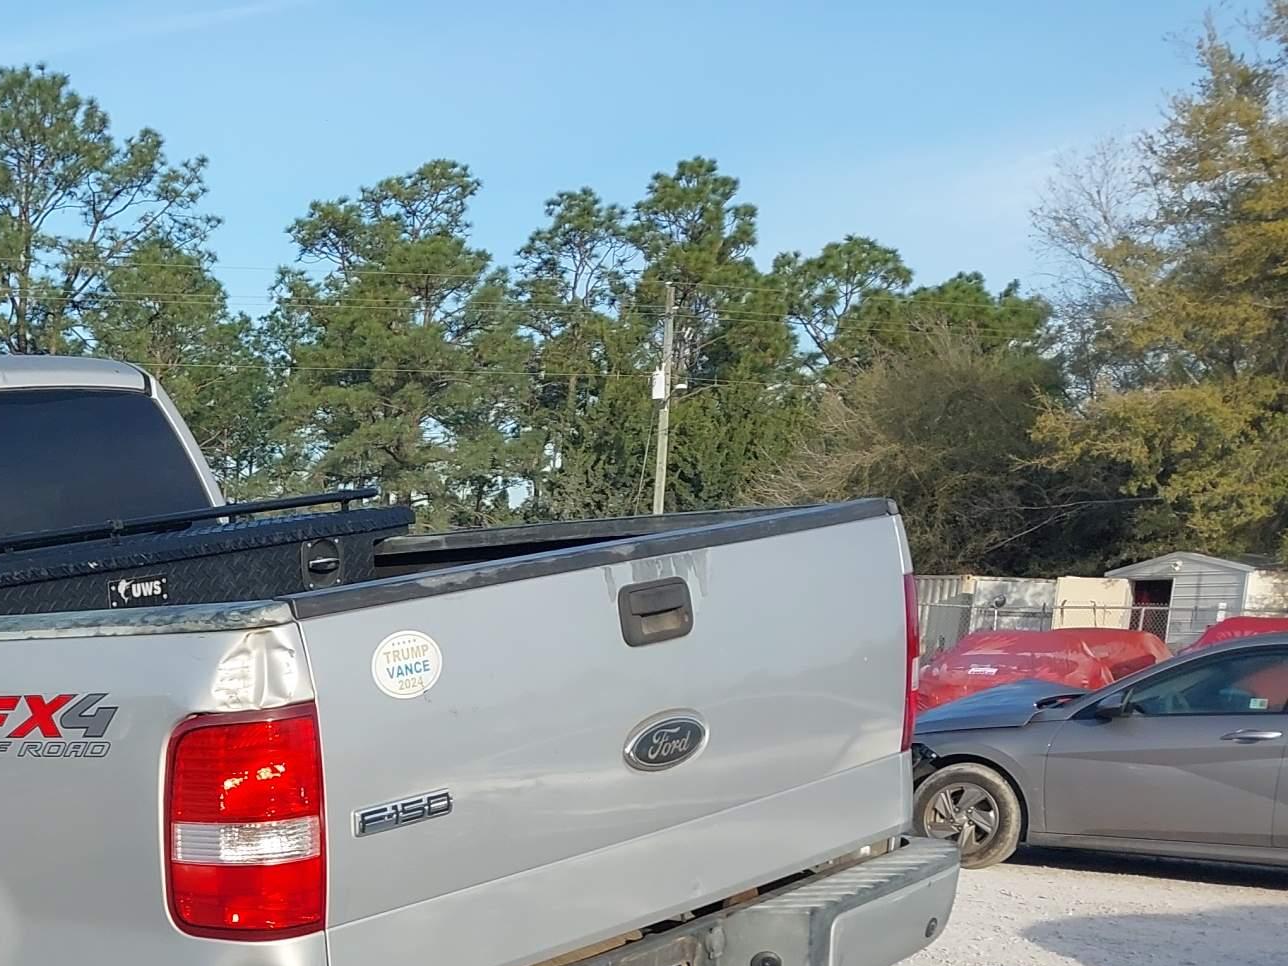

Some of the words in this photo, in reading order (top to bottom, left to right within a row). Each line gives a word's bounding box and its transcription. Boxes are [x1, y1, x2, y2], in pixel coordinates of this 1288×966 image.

[131, 580, 162, 598] UWS
[383, 643, 430, 665] TRUMP
[386, 659, 431, 679] VANCE
[398, 676, 425, 691] 2024
[17, 741, 111, 758] ROAD
[647, 726, 691, 760] Ford
